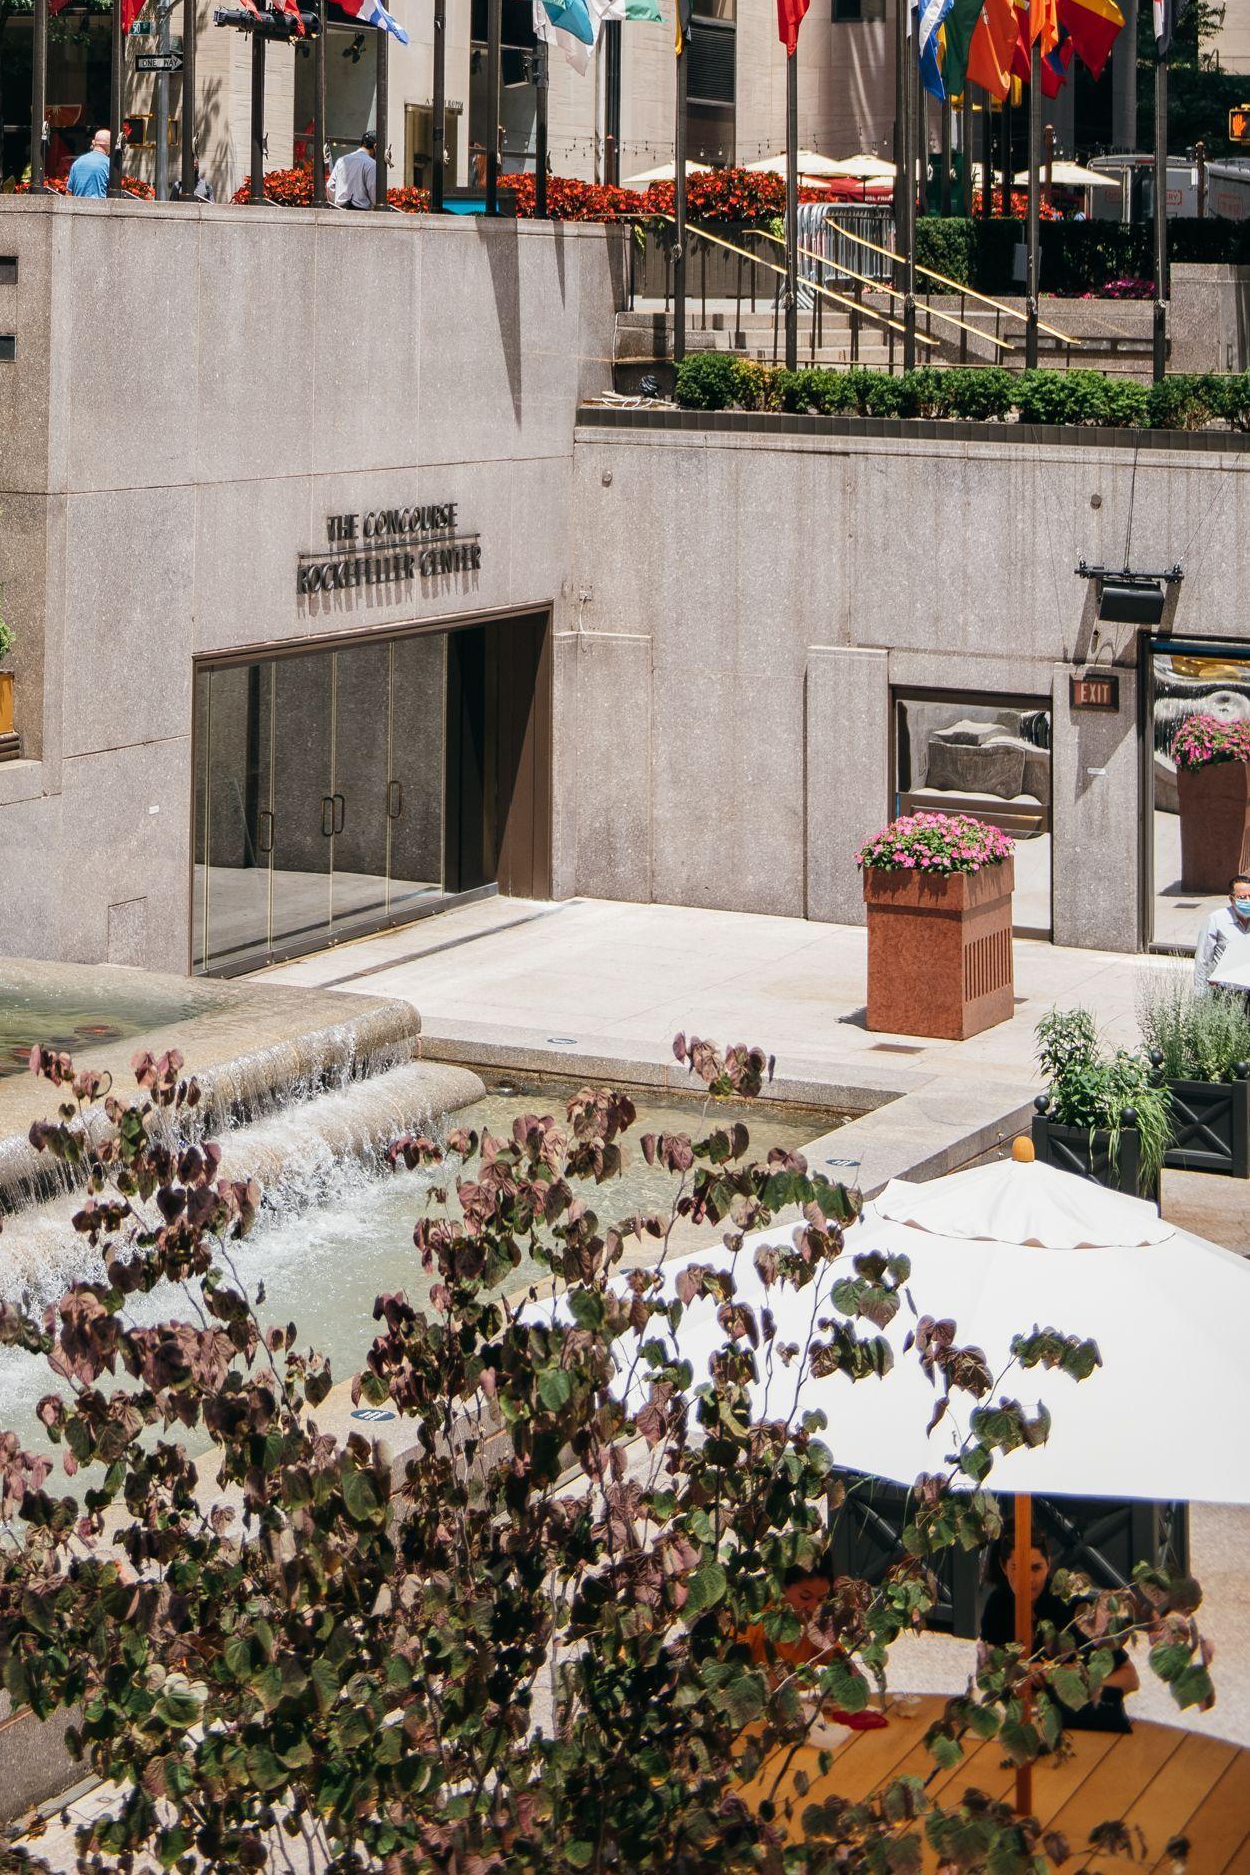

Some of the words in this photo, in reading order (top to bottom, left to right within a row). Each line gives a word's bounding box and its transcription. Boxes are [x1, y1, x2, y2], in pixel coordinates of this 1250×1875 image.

[142, 59, 157, 67] ONE
[163, 59, 178, 67] WAY
[327, 514, 359, 542] THE
[363, 503, 458, 538] CONCOURSE
[297, 553, 414, 594] ROCKEFELLER
[420, 545, 482, 577] CENTER
[1080, 682, 1109, 704] EXIT
